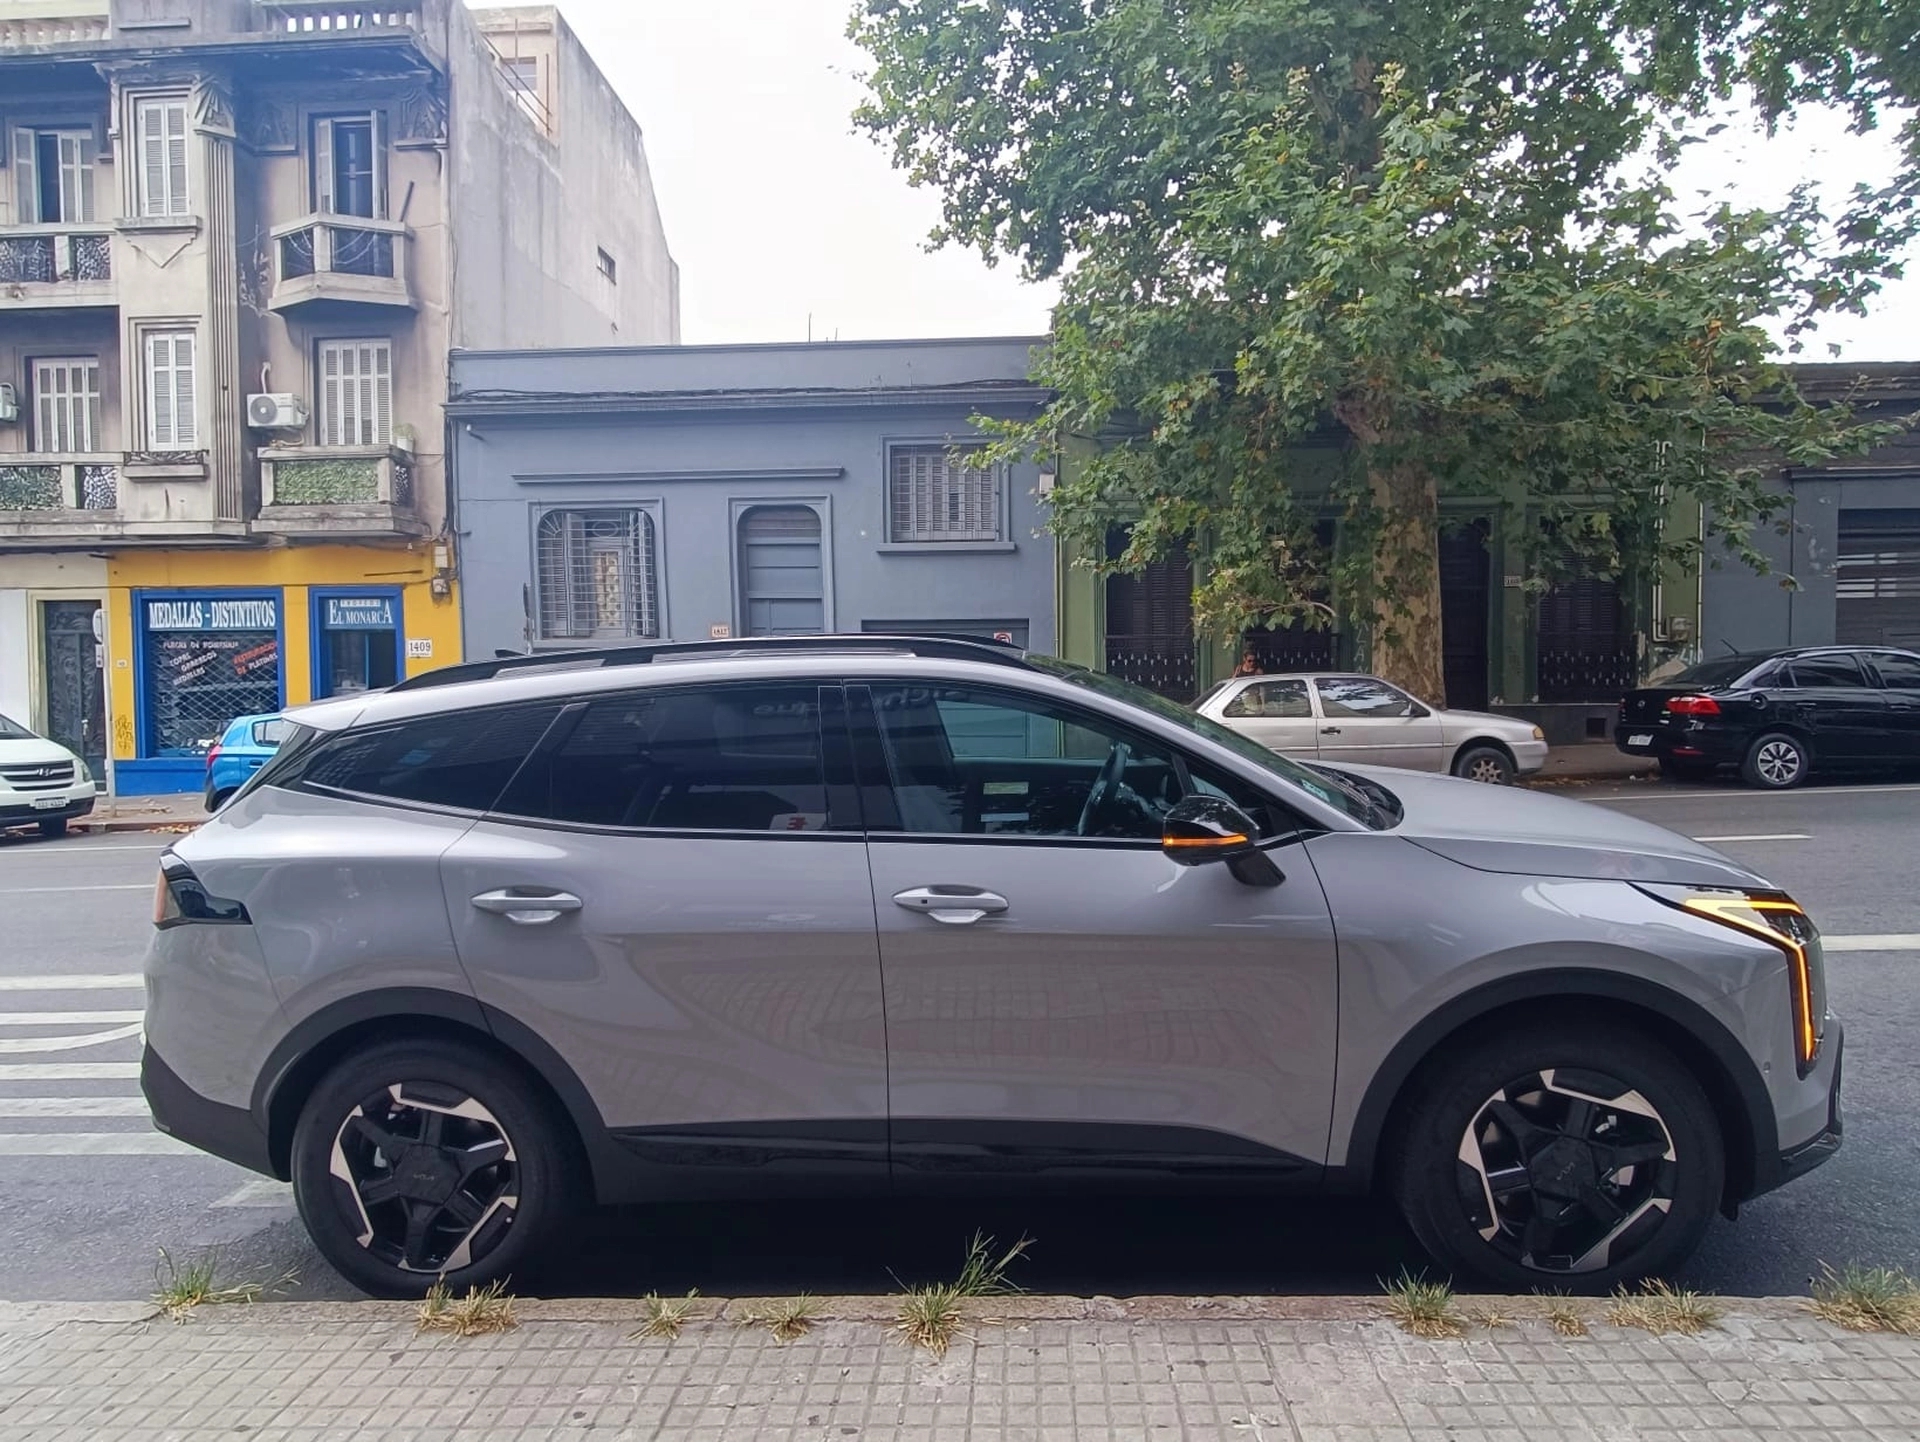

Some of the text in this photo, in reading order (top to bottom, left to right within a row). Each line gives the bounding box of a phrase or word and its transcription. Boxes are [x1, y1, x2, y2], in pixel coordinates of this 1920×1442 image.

[149, 601, 203, 628] MEDALLAS
[211, 600, 275, 627] DISTINTIVOS
[345, 599, 393, 624] MONARCA
[410, 641, 431, 651] 1409
